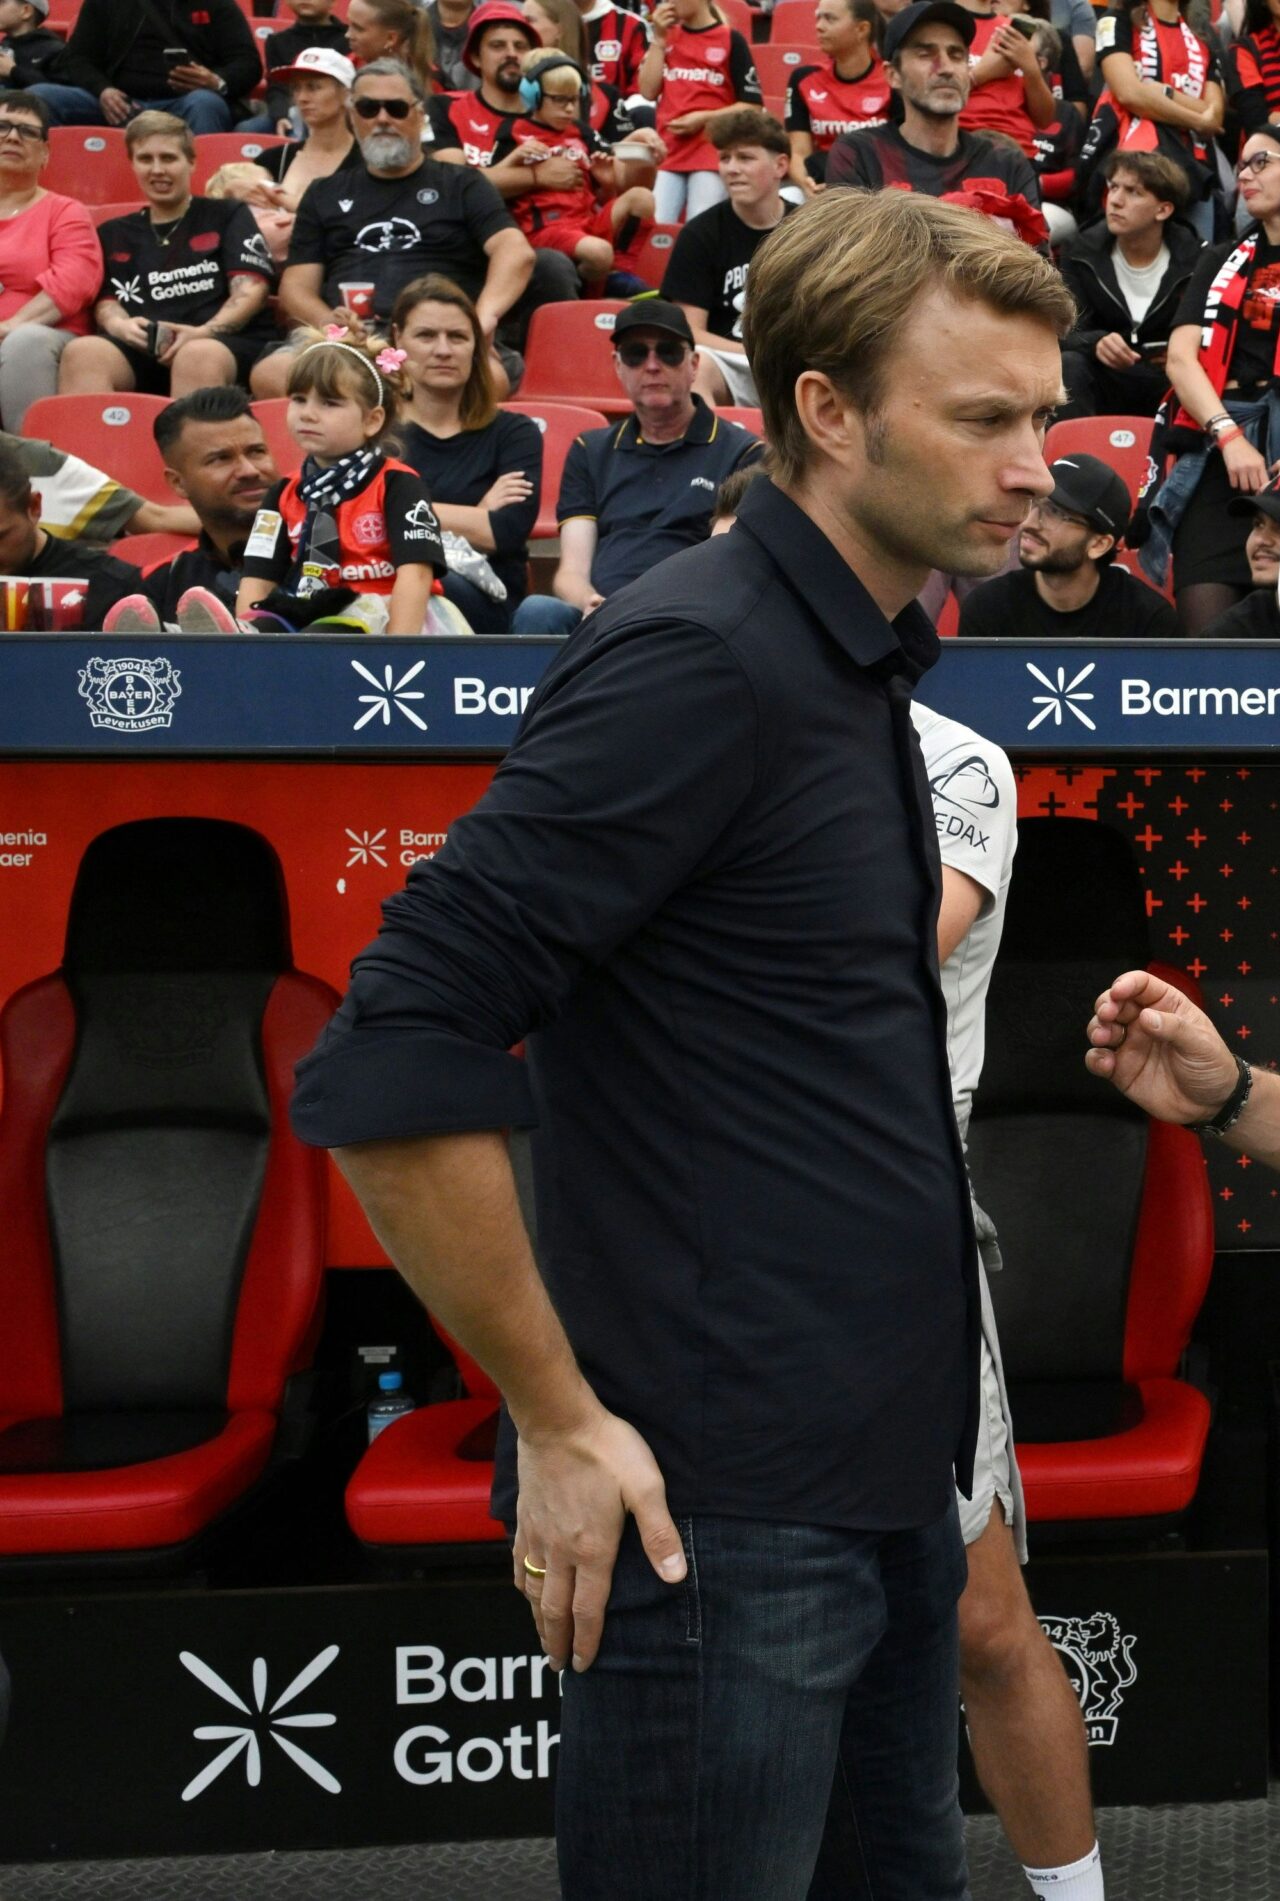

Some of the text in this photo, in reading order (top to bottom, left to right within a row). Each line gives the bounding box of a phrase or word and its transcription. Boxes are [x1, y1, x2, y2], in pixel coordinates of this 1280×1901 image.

[148, 259, 220, 285] Barmenia
[150, 277, 215, 301] Gothaer
[340, 559, 396, 582] enia
[117, 661, 141, 671] 1904
[109, 690, 152, 700] BAYER
[125, 675, 136, 715] BAYER
[97, 714, 166, 730] Leverkusen
[0, 828, 47, 846] enia
[934, 812, 991, 853] EDAX
